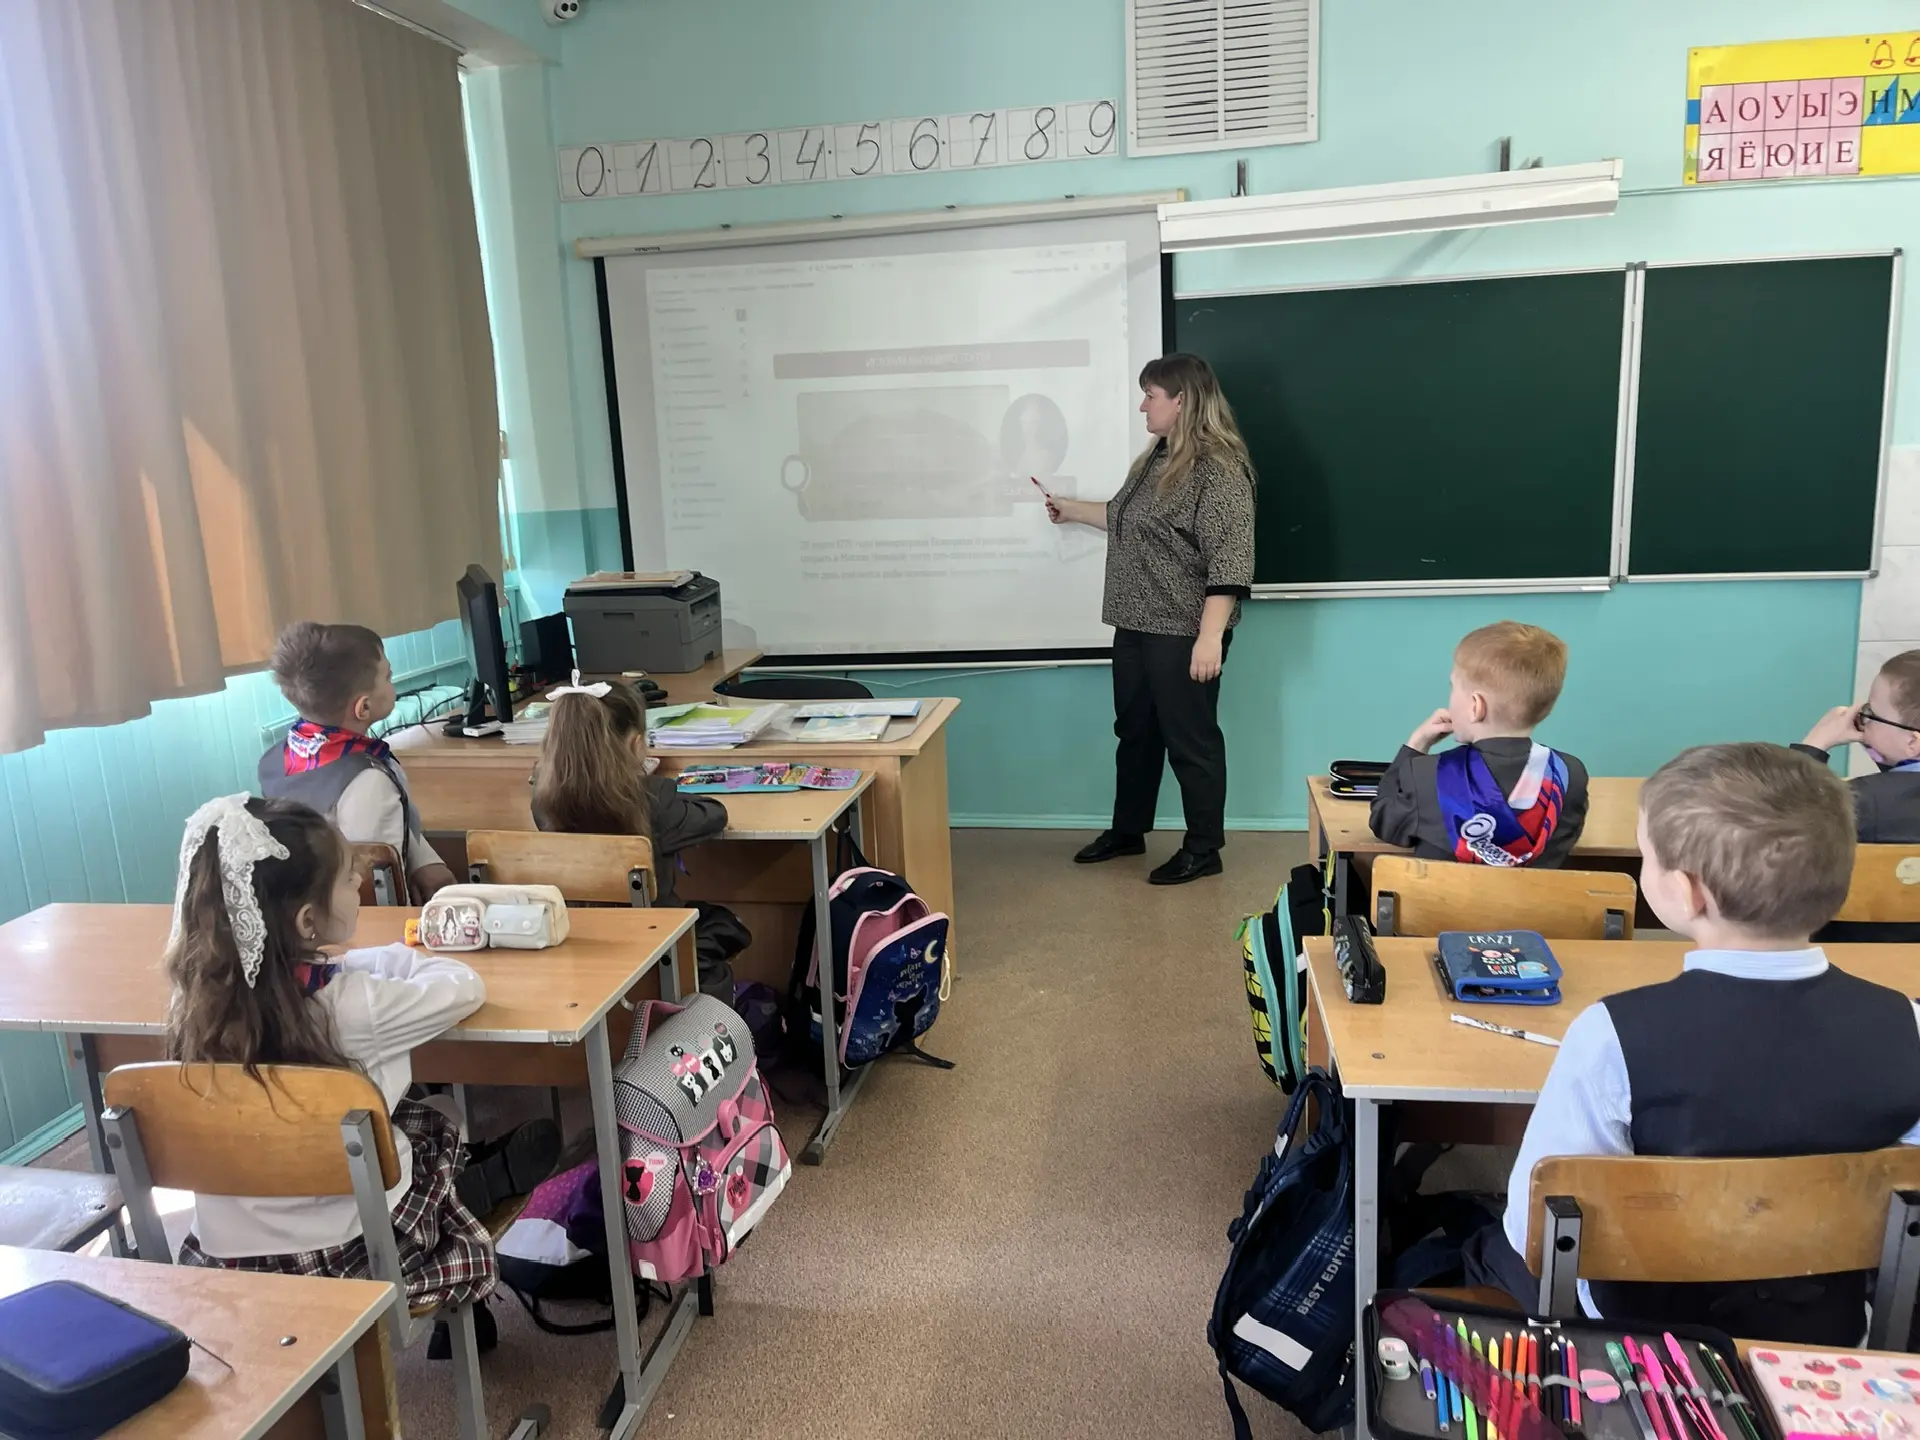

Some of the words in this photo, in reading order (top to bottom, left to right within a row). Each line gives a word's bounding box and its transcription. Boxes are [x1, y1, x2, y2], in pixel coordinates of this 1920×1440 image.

[1705, 99, 1727, 124] А
[1738, 97, 1761, 121] О
[1771, 94, 1794, 119] У
[1801, 92, 1828, 118] Ы
[1838, 91, 1858, 116] Э
[1870, 89, 1892, 114] Н
[576, 146, 605, 197] 0
[635, 142, 657, 193] 1
[690, 138, 716, 189] 2
[744, 133, 770, 184] 3
[796, 129, 824, 180] 4
[850, 122, 880, 175] 5
[909, 118, 940, 170] 6
[969, 112, 996, 165] 7
[1024, 107, 1056, 160] 8
[1083, 100, 1116, 155] 9
[1703, 147, 1726, 171] Я
[1739, 141, 1757, 169] Ё
[1765, 143, 1795, 168] Ю
[1801, 142, 1823, 165] И
[1837, 140, 1854, 163] Е
[1468, 934, 1513, 945] CRAZY
[1296, 1281, 1325, 1315] BEST
